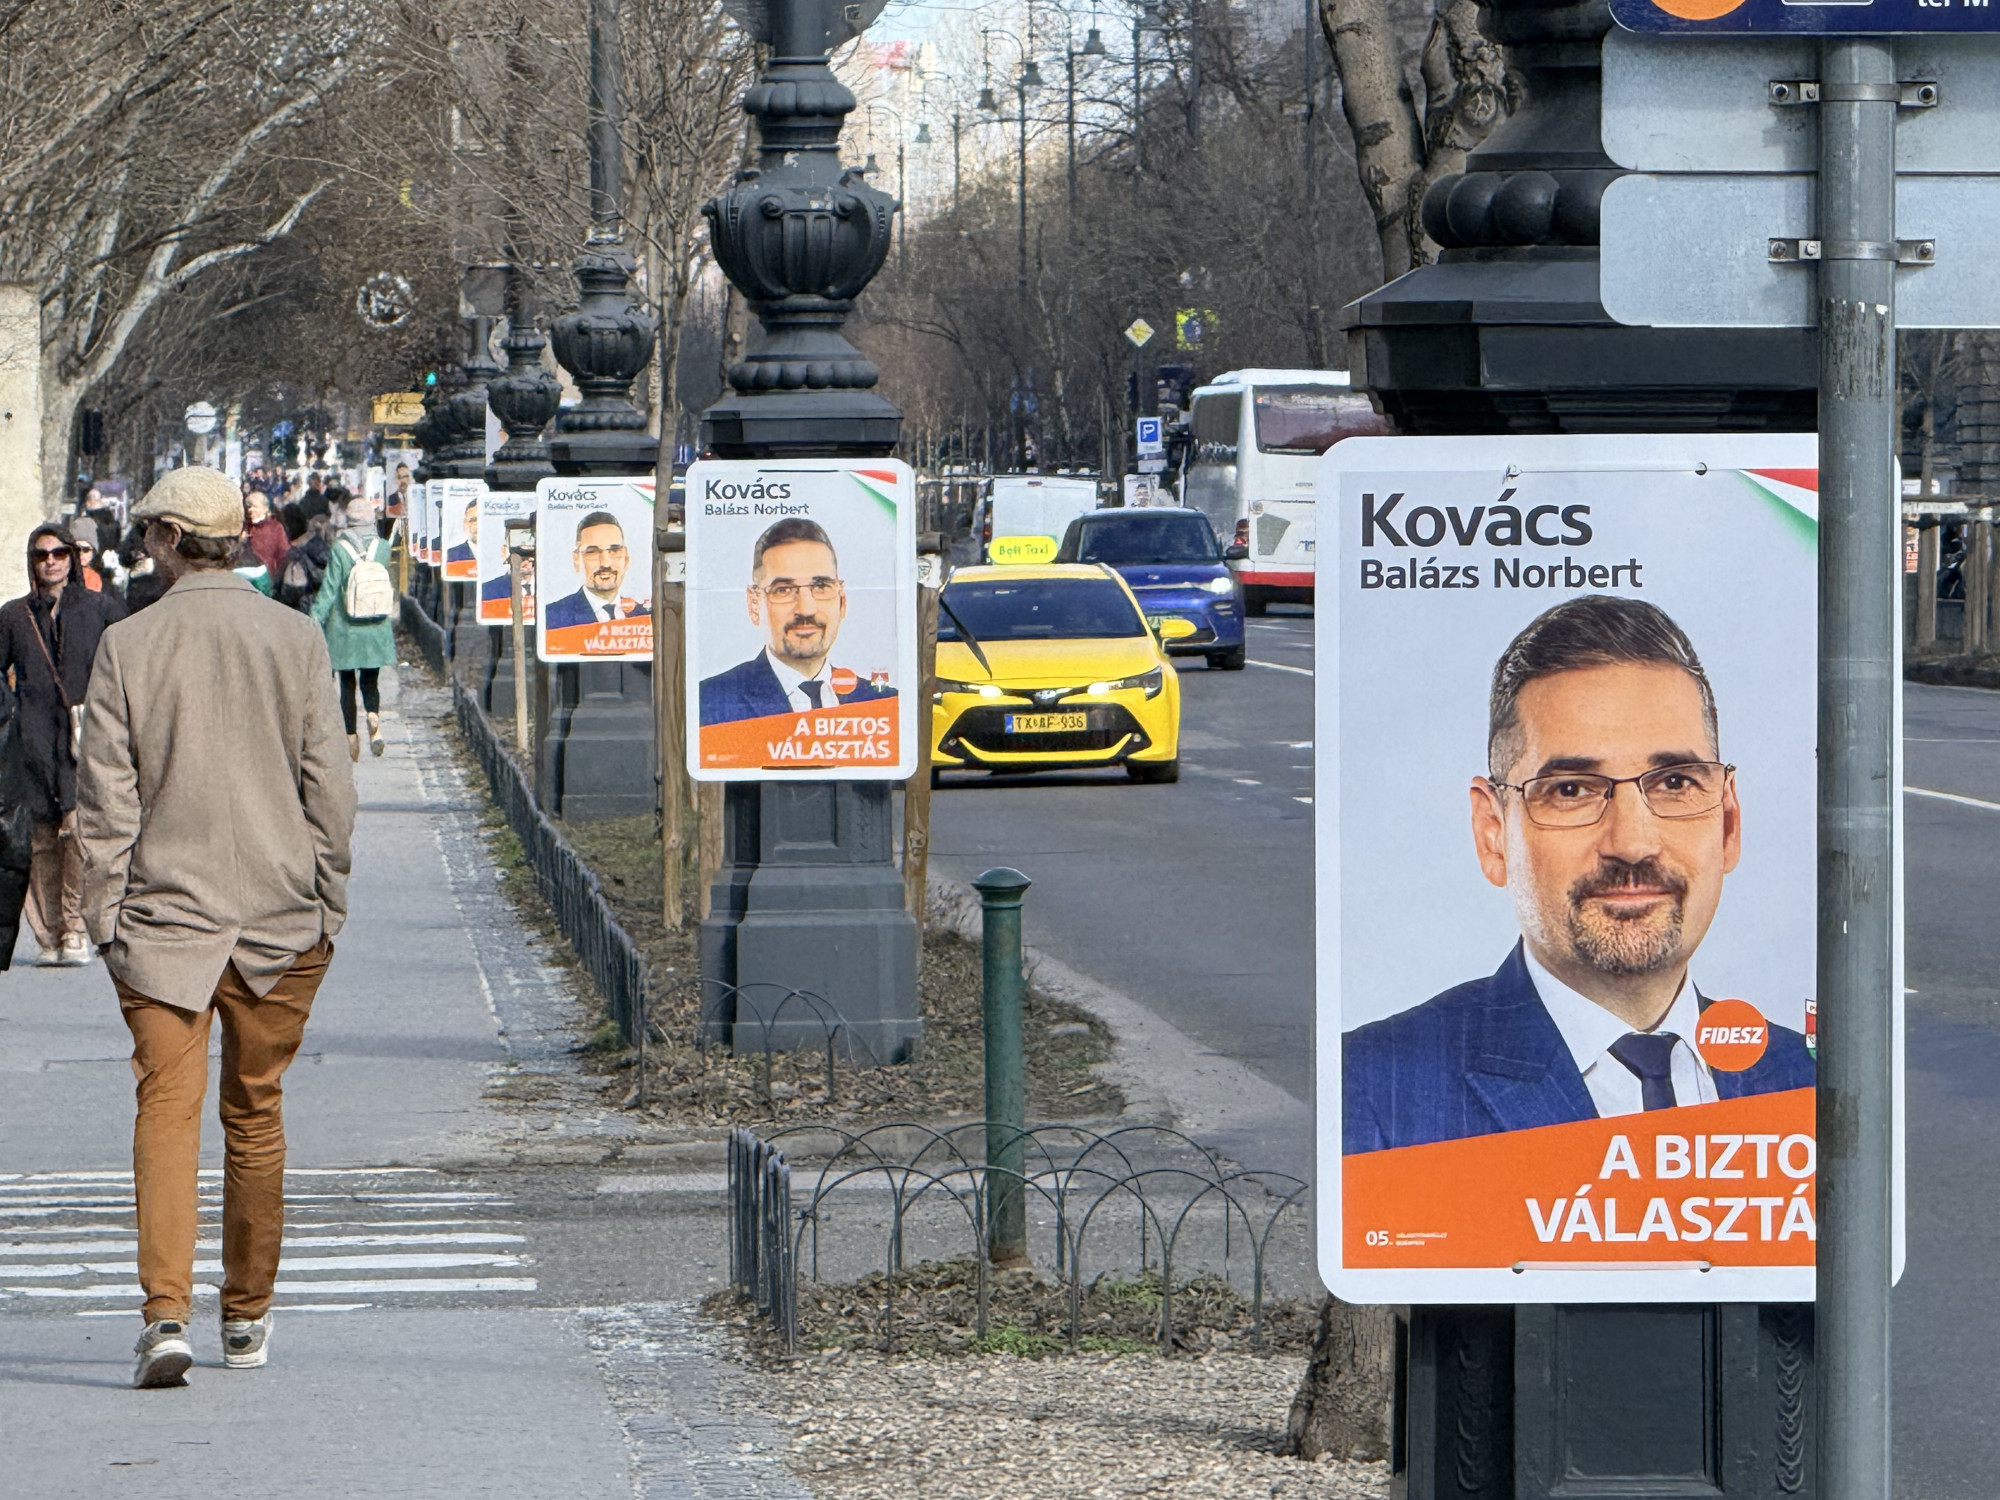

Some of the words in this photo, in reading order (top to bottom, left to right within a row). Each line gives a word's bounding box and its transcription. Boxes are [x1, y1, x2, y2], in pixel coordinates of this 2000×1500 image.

[705, 477, 791, 500] Kovács
[754, 503, 809, 515] Norbert
[1361, 488, 1592, 547] Kovács
[1360, 556, 1479, 588] Balázs
[1494, 556, 1643, 588] Norbert
[794, 718, 811, 736] A
[815, 717, 891, 736] BIZTOS
[766, 736, 891, 760] VÁLASZTÁS
[1699, 1027, 1765, 1045] FIDESZ
[1598, 1134, 1641, 1179] A
[1656, 1134, 1817, 1179] BIZTO
[1525, 1183, 1817, 1242] VÁLASZTÁ
